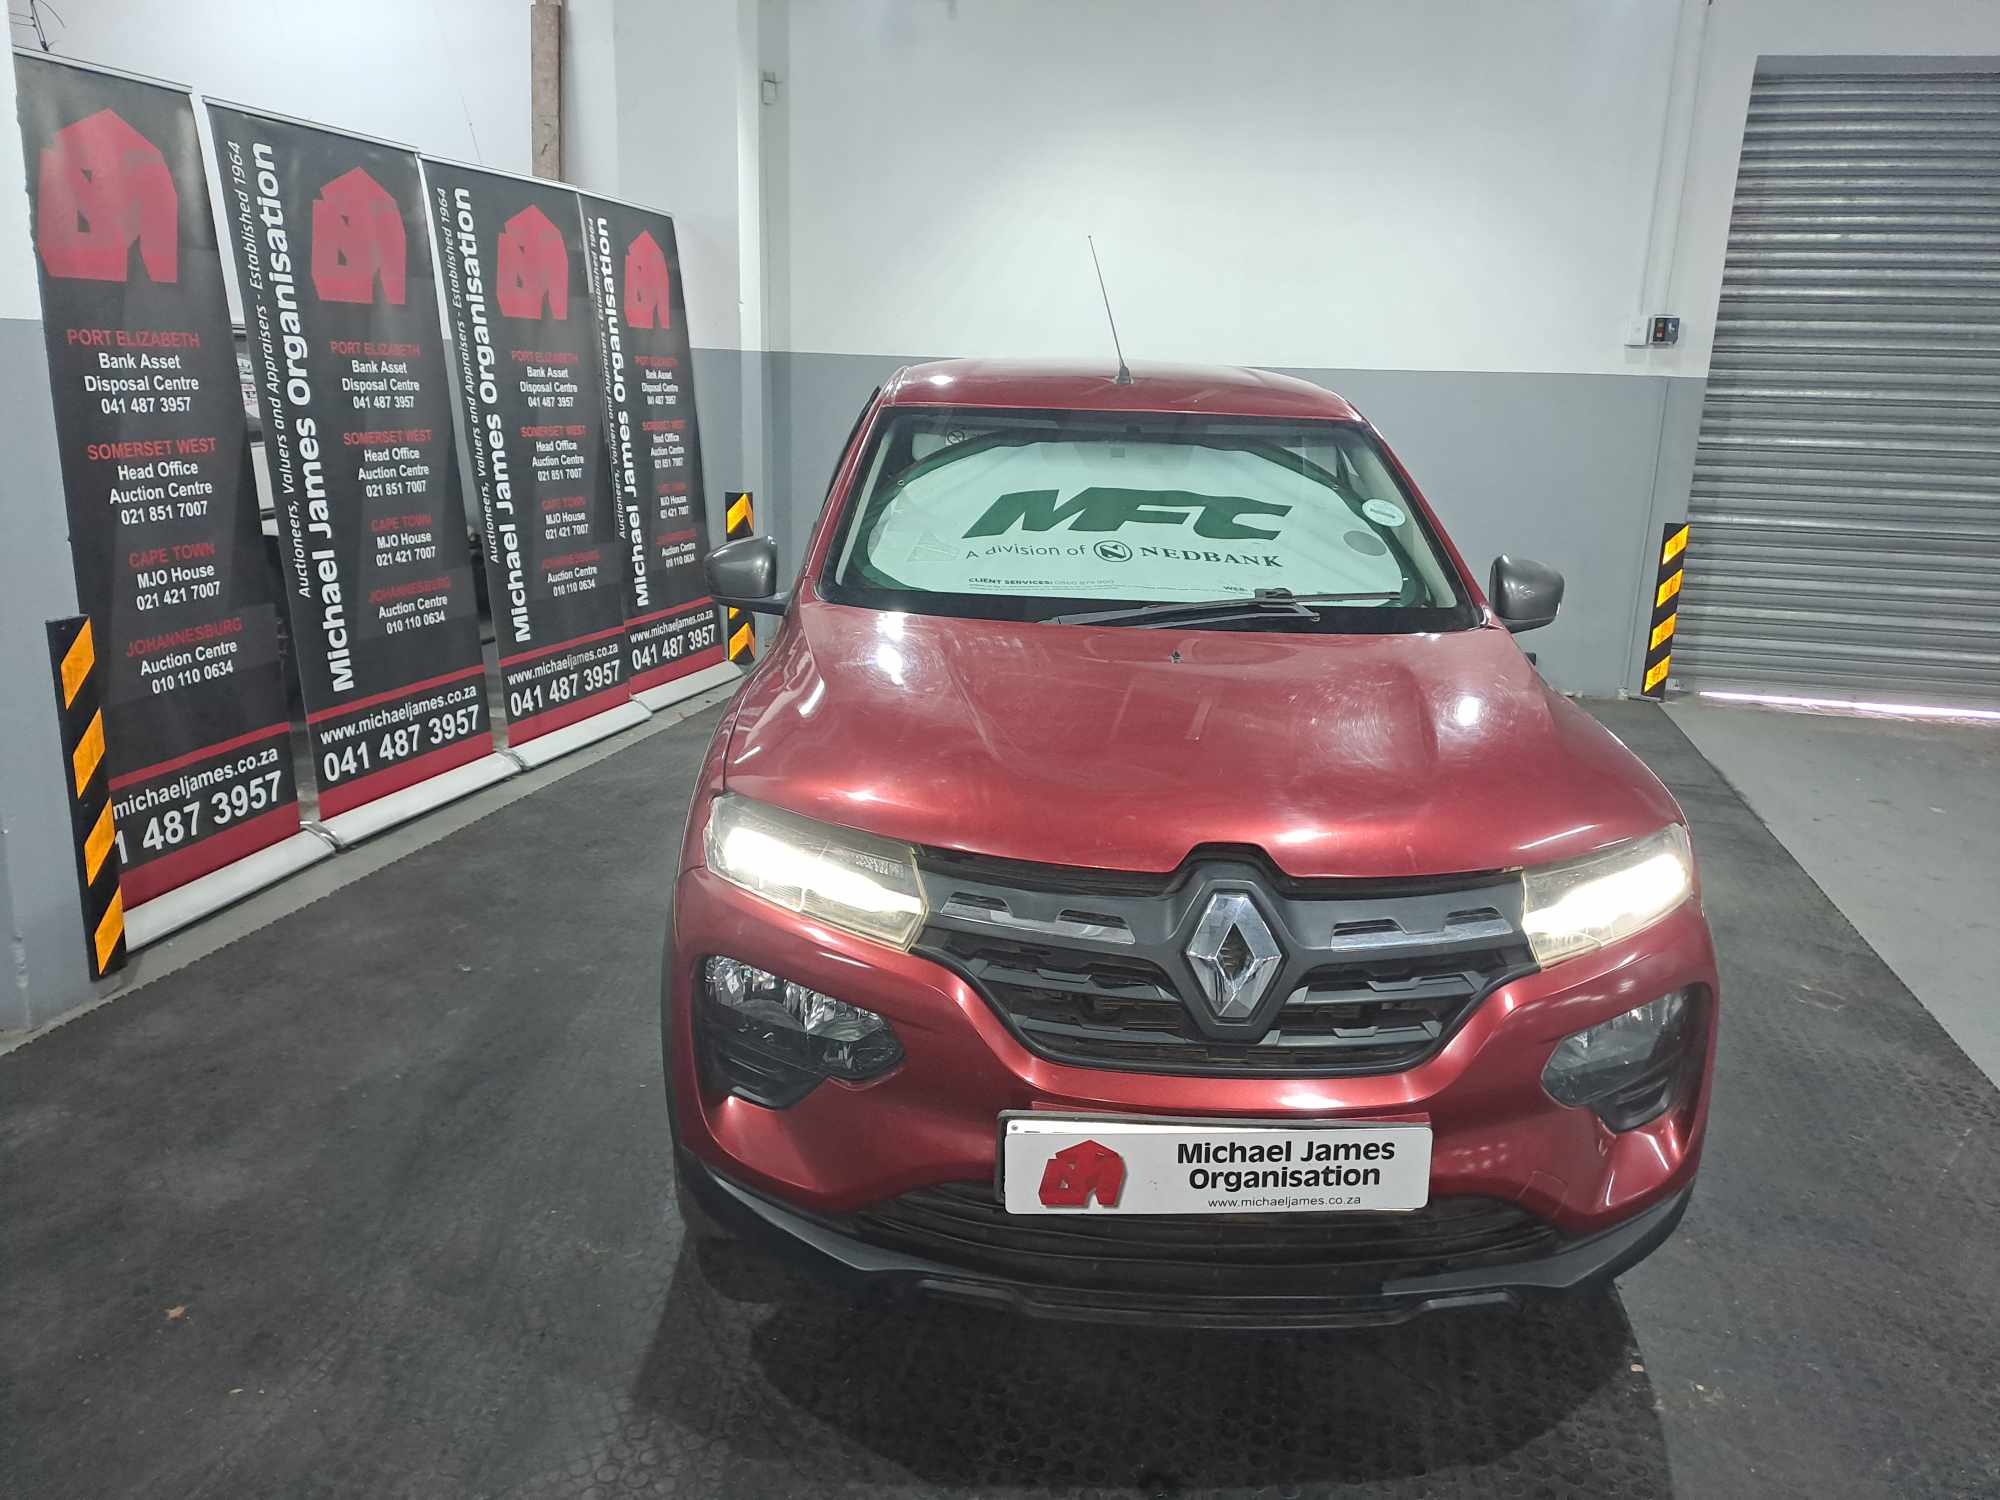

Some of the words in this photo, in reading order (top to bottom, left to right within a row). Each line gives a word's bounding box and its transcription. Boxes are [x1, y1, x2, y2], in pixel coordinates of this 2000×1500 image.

[228, 140, 247, 186] 1964
[436, 187, 450, 224] 1964
[234, 188, 264, 290] Established
[252, 142, 311, 406] Organisation
[440, 226, 462, 309] Established
[454, 187, 498, 405] Organisation
[597, 217, 627, 403] Organisation
[67, 329, 111, 346] PORT
[116, 331, 200, 348] ELIZABETH
[256, 304, 280, 394] Appraisers
[98, 352, 136, 369] Bank
[140, 353, 181, 369] Asset
[352, 360, 378, 373] Bank
[381, 361, 408, 374] Asset
[458, 321, 475, 396] Appraisers
[526, 366, 545, 378] Bank
[84, 375, 149, 394] Disposal
[154, 375, 199, 391] Centre
[342, 378, 387, 393] Disposal
[390, 378, 420, 391] Centre
[520, 381, 552, 394] Disposal
[554, 382, 578, 393] Centre
[101, 398, 126, 414] 041
[130, 398, 154, 413] 487
[160, 397, 191, 412] 3957
[272, 397, 286, 430] and
[353, 396, 370, 409] 041
[374, 396, 391, 408] 487
[394, 396, 414, 408] 3957
[88, 440, 172, 460] SOMERSET
[176, 438, 216, 454] WEST
[364, 449, 390, 462] Head
[392, 448, 420, 460] Office
[472, 427, 487, 477] Valuers
[532, 455, 560, 468] Auction
[560, 454, 584, 466] Centre
[536, 440, 554, 452] Head
[618, 411, 638, 498] James
[118, 463, 154, 480] Head
[158, 461, 198, 477] Office
[277, 434, 294, 494] Valuers
[296, 418, 333, 539] James
[358, 466, 396, 481] Auction
[399, 464, 430, 477] Centre
[486, 414, 514, 515] James
[110, 485, 164, 504] Auction
[168, 481, 212, 498] Centre
[366, 484, 382, 498] 021
[386, 482, 402, 496] 851
[406, 480, 426, 493] 7007
[121, 508, 144, 524] 021
[149, 504, 173, 522] 851
[177, 501, 208, 518] 7007
[478, 483, 500, 563] Auctioneers,
[562, 512, 586, 522] House
[962, 486, 1293, 541] MFC
[128, 548, 168, 568] CAPE
[173, 544, 215, 561] TOWN
[287, 501, 311, 598] Auctioneers,
[376, 534, 398, 549] MJO
[400, 532, 432, 546] House
[626, 504, 649, 608] Michael
[966, 550, 979, 560] A
[985, 543, 1060, 558] division
[1066, 544, 1087, 556] of
[1138, 546, 1284, 568] NEDBANK
[376, 552, 392, 567] 021
[395, 550, 412, 562] 421
[414, 546, 436, 560] 7007
[137, 570, 167, 589] MJO
[171, 564, 214, 582] House
[500, 523, 531, 643] Michael
[548, 570, 574, 584] Auction
[136, 594, 160, 611] 021
[164, 587, 187, 605] 421
[191, 581, 220, 600] 7007
[378, 602, 416, 619] Auction
[417, 595, 448, 610] Centre
[128, 618, 242, 656] JOHANNESBURG
[312, 550, 354, 693] Michael
[386, 620, 402, 634] 010
[405, 616, 421, 630] 110
[424, 610, 446, 626] 0634
[630, 610, 714, 644] www.michaeljames.co.za
[140, 653, 192, 676] Auction
[196, 642, 238, 661] Centre
[632, 645, 658, 670] 041
[662, 634, 684, 660] 487
[688, 624, 716, 650] 3957
[152, 676, 174, 694] 010
[178, 668, 200, 686] 110
[204, 660, 234, 680] 0634
[507, 642, 619, 686] www.michaeljames.co.za
[510, 685, 544, 717] 041
[549, 673, 579, 702] 487
[584, 658, 620, 691] 3957
[320, 686, 477, 744] www.michaeljames.co.za
[324, 741, 370, 782] 041
[379, 724, 420, 761] 487
[428, 704, 479, 744] 3957
[143, 802, 200, 851] 487
[211, 770, 282, 825] 3957
[1177, 1141, 1292, 1164] Michael
[1300, 1141, 1395, 1162] James
[1189, 1166, 1381, 1192] Organisation
[1208, 1197, 1361, 1208] www.michaeljames.co.za
